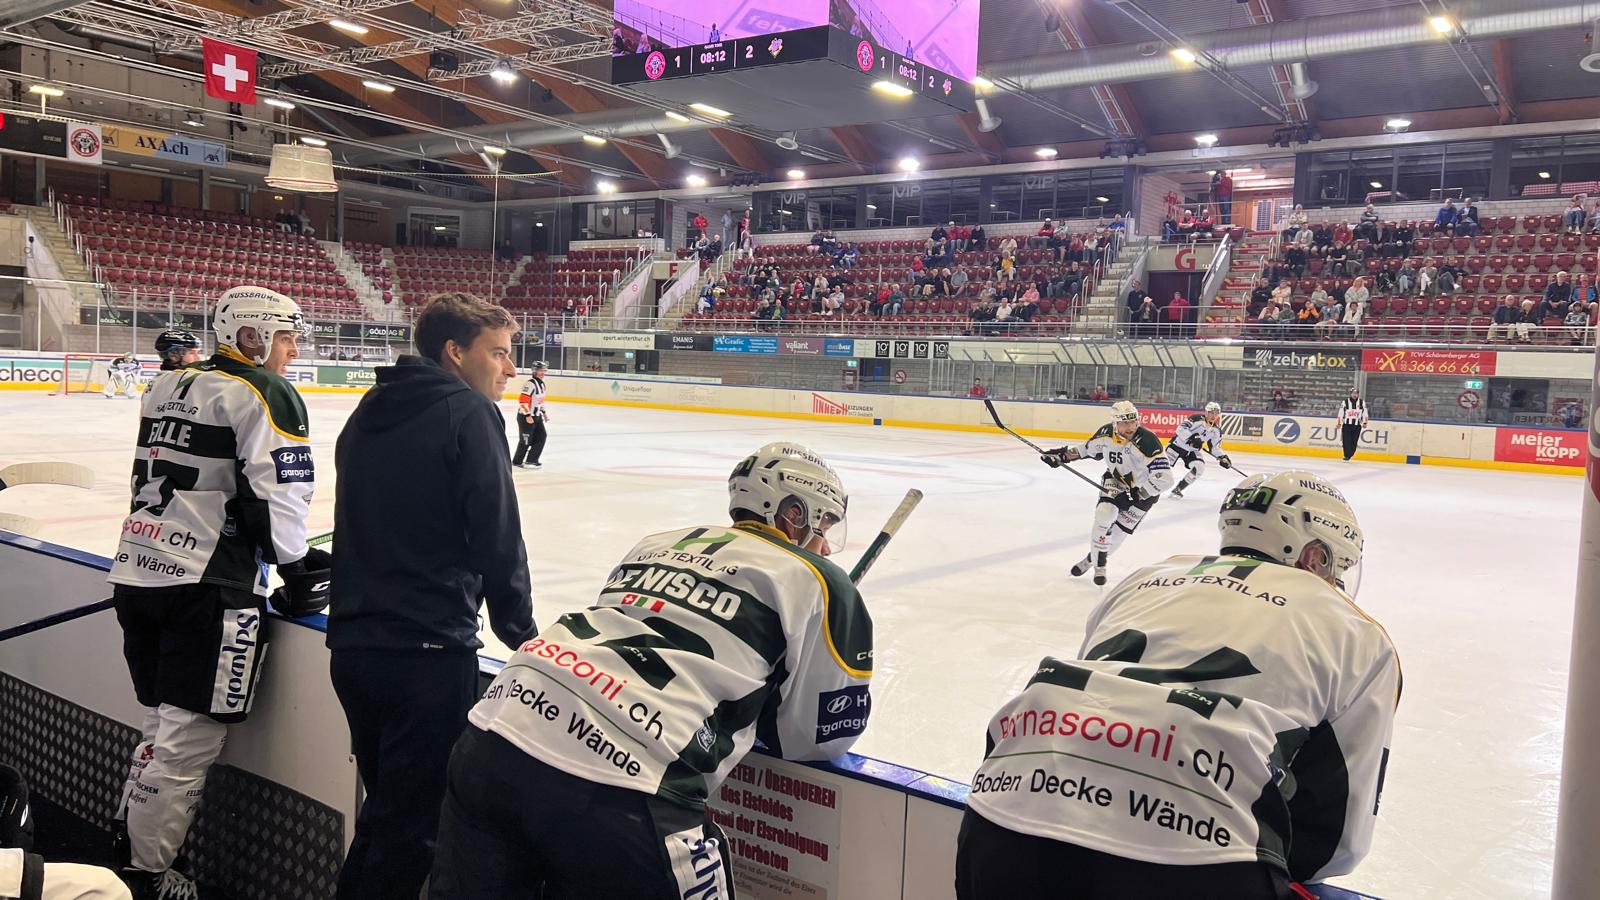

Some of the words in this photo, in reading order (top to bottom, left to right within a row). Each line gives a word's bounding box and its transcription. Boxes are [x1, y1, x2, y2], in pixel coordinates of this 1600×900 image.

[700, 50, 726, 64] 08:12
[745, 45, 754, 59] 2
[674, 55, 681, 68] 1
[880, 56, 886, 69] 1
[899, 65, 917, 80] 08:12
[929, 75, 934, 88] 2
[135, 134, 189, 156] AXA.ch
[895, 184, 922, 199] VIP
[1025, 176, 1056, 191] VIP
[784, 193, 806, 206] VIP
[1175, 247, 1196, 270] G
[236, 312, 259, 320] CCM
[262, 313, 275, 321] 27
[1408, 361, 1434, 372] 366
[1438, 361, 1457, 373] 66
[1310, 426, 1388, 445] ZUCH
[1511, 432, 1563, 447] Meier
[1109, 451, 1123, 464] 65
[1536, 446, 1580, 460] KOPP
[786, 475, 813, 487] CCM
[816, 482, 830, 496] 22
[1312, 515, 1340, 530] CCM
[1343, 525, 1358, 541] 24
[137, 553, 186, 577] Wände
[670, 552, 715, 572] TEXTIL
[1137, 577, 1186, 590] HÄLG
[1191, 576, 1252, 597] TEXTIL
[1256, 592, 1287, 607] AG
[521, 638, 664, 742] asconi.ch
[1175, 689, 1213, 707] CCM
[567, 712, 641, 777] Wände
[765, 768, 836, 809] ÜBERQUEREN
[721, 784, 741, 806] des
[742, 789, 793, 822] Eisfeldes
[972, 773, 1022, 795] Boden
[1031, 768, 1113, 808] Decke
[1127, 790, 1231, 848] Wände
[736, 813, 755, 835] der
[757, 819, 829, 862] Eisreinigung
[737, 838, 788, 873] Verboten
